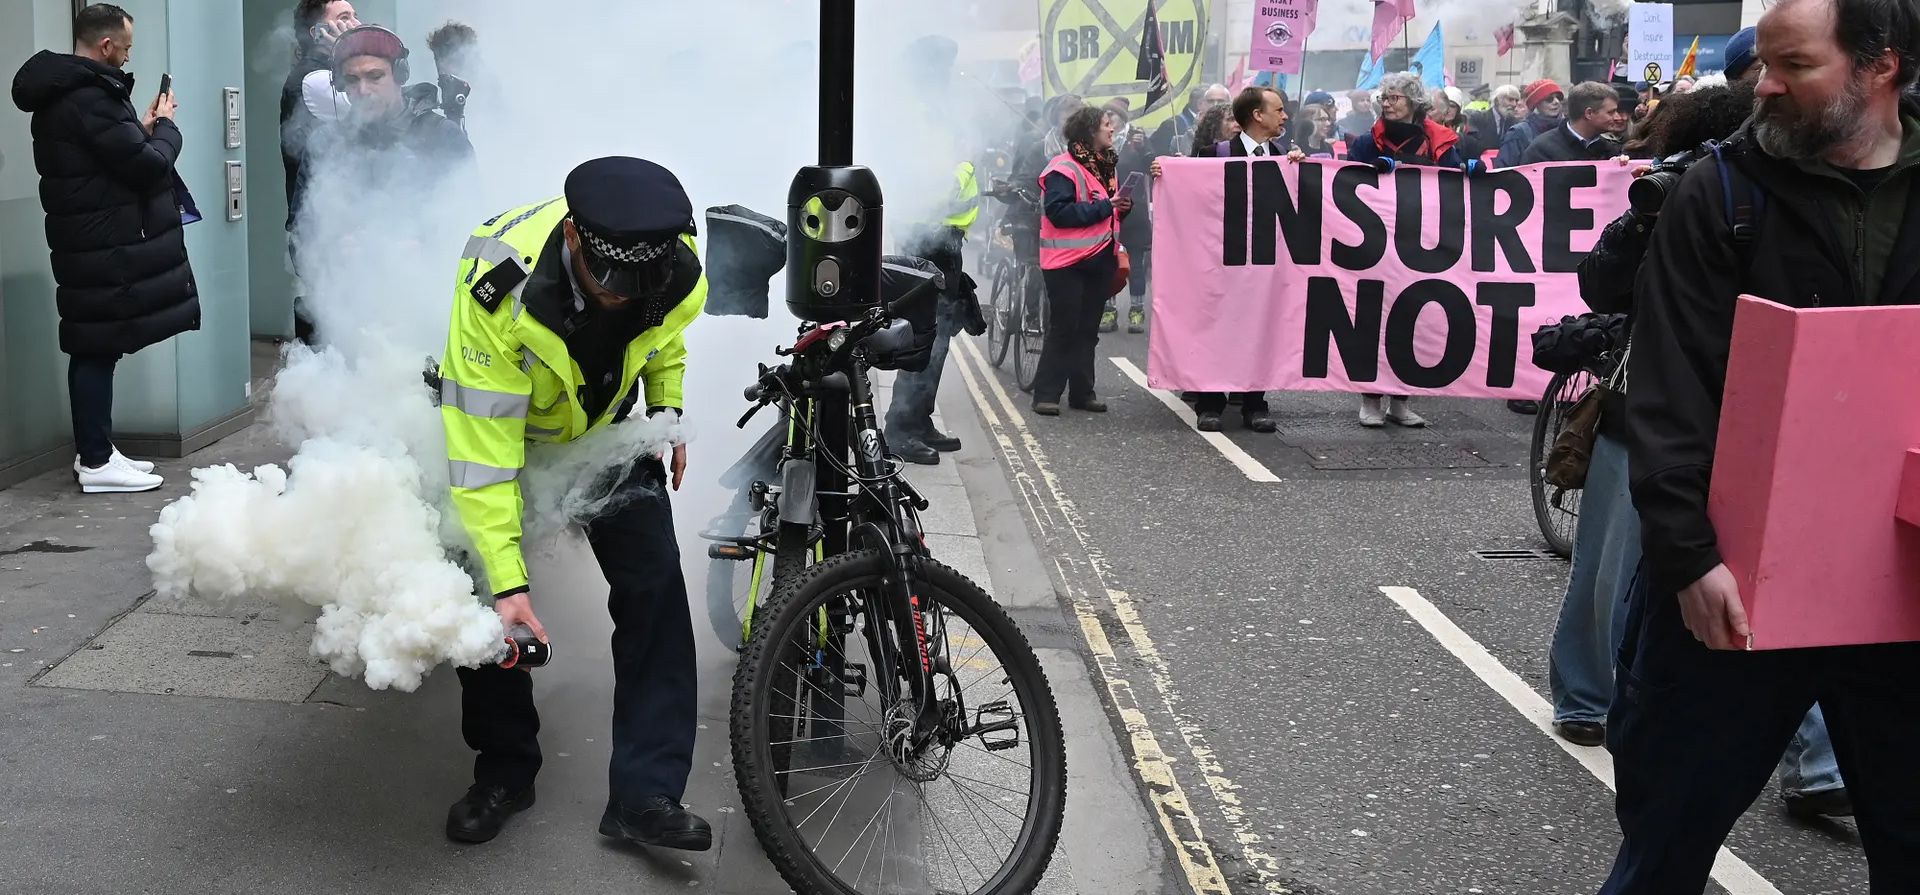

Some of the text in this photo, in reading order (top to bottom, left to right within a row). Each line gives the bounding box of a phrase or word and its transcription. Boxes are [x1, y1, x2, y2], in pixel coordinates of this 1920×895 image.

[1261, 7, 1299, 19] BUSINESS
[1633, 49, 1673, 61] Destruction
[1460, 61, 1476, 73] 88
[1223, 160, 1597, 274] INSURE
[476, 286, 493, 303] 2547
[483, 281, 496, 295] NW
[1302, 276, 1535, 389] NOT
[461, 346, 492, 367] OLICE
